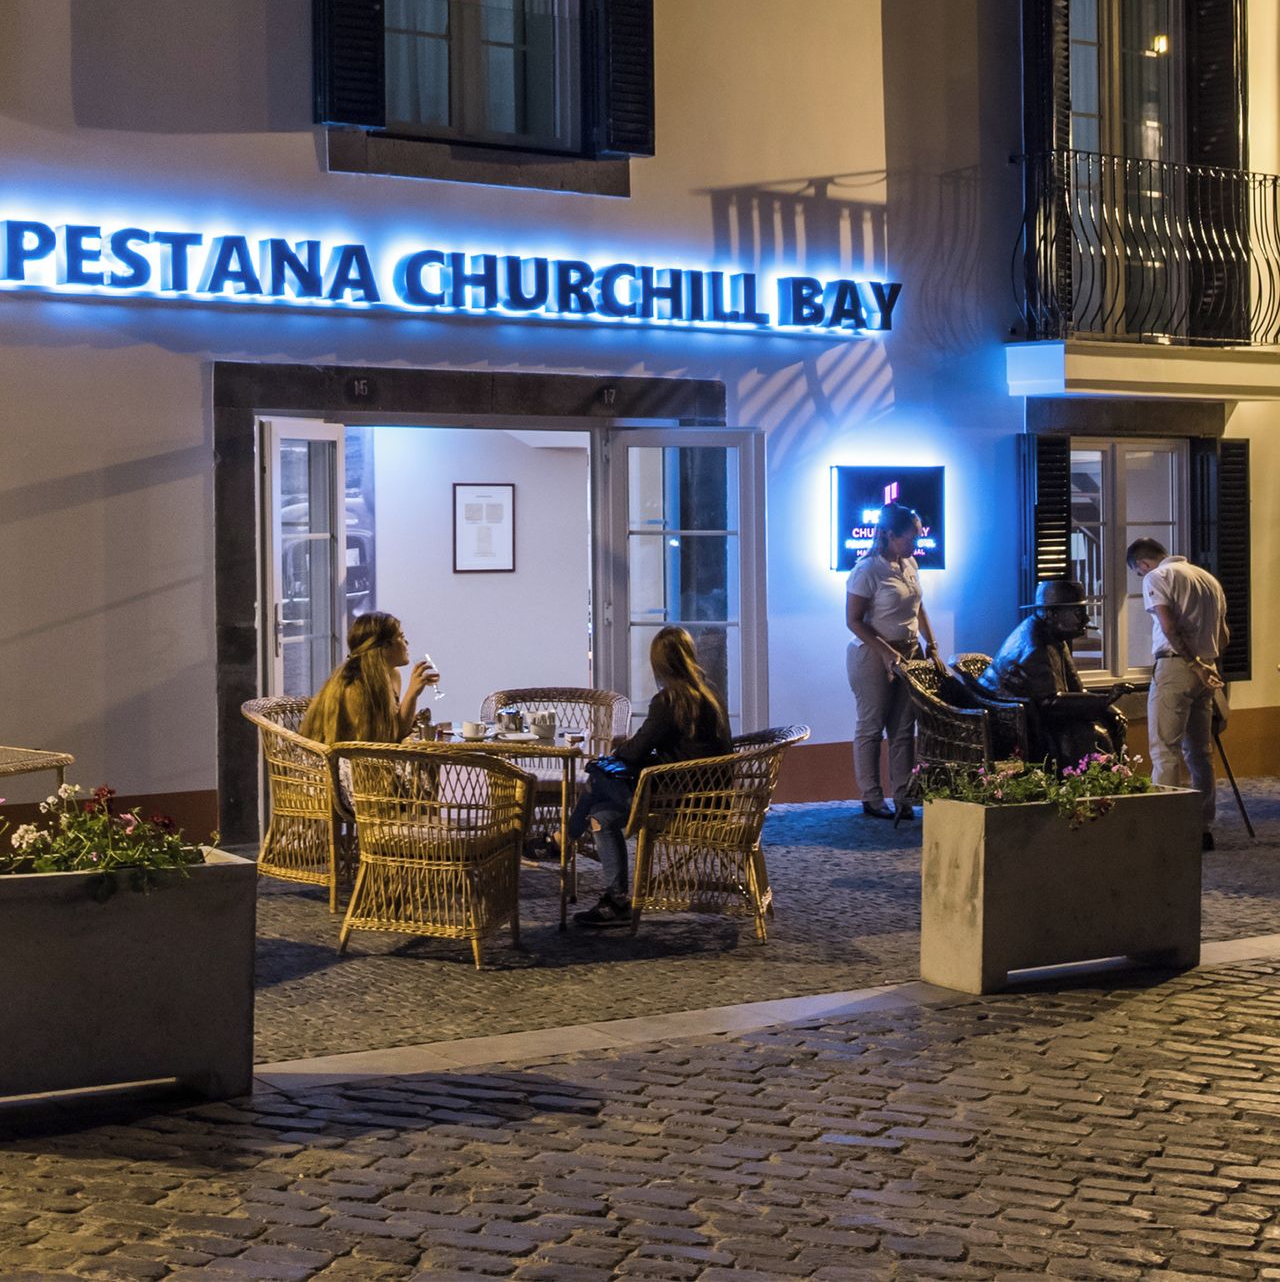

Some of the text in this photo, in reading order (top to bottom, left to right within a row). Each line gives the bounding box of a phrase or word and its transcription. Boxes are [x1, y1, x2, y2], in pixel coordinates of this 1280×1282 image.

[393, 248, 769, 324] CHURCHILL
[777, 275, 904, 331] BAY
[603, 389, 617, 405] 17
